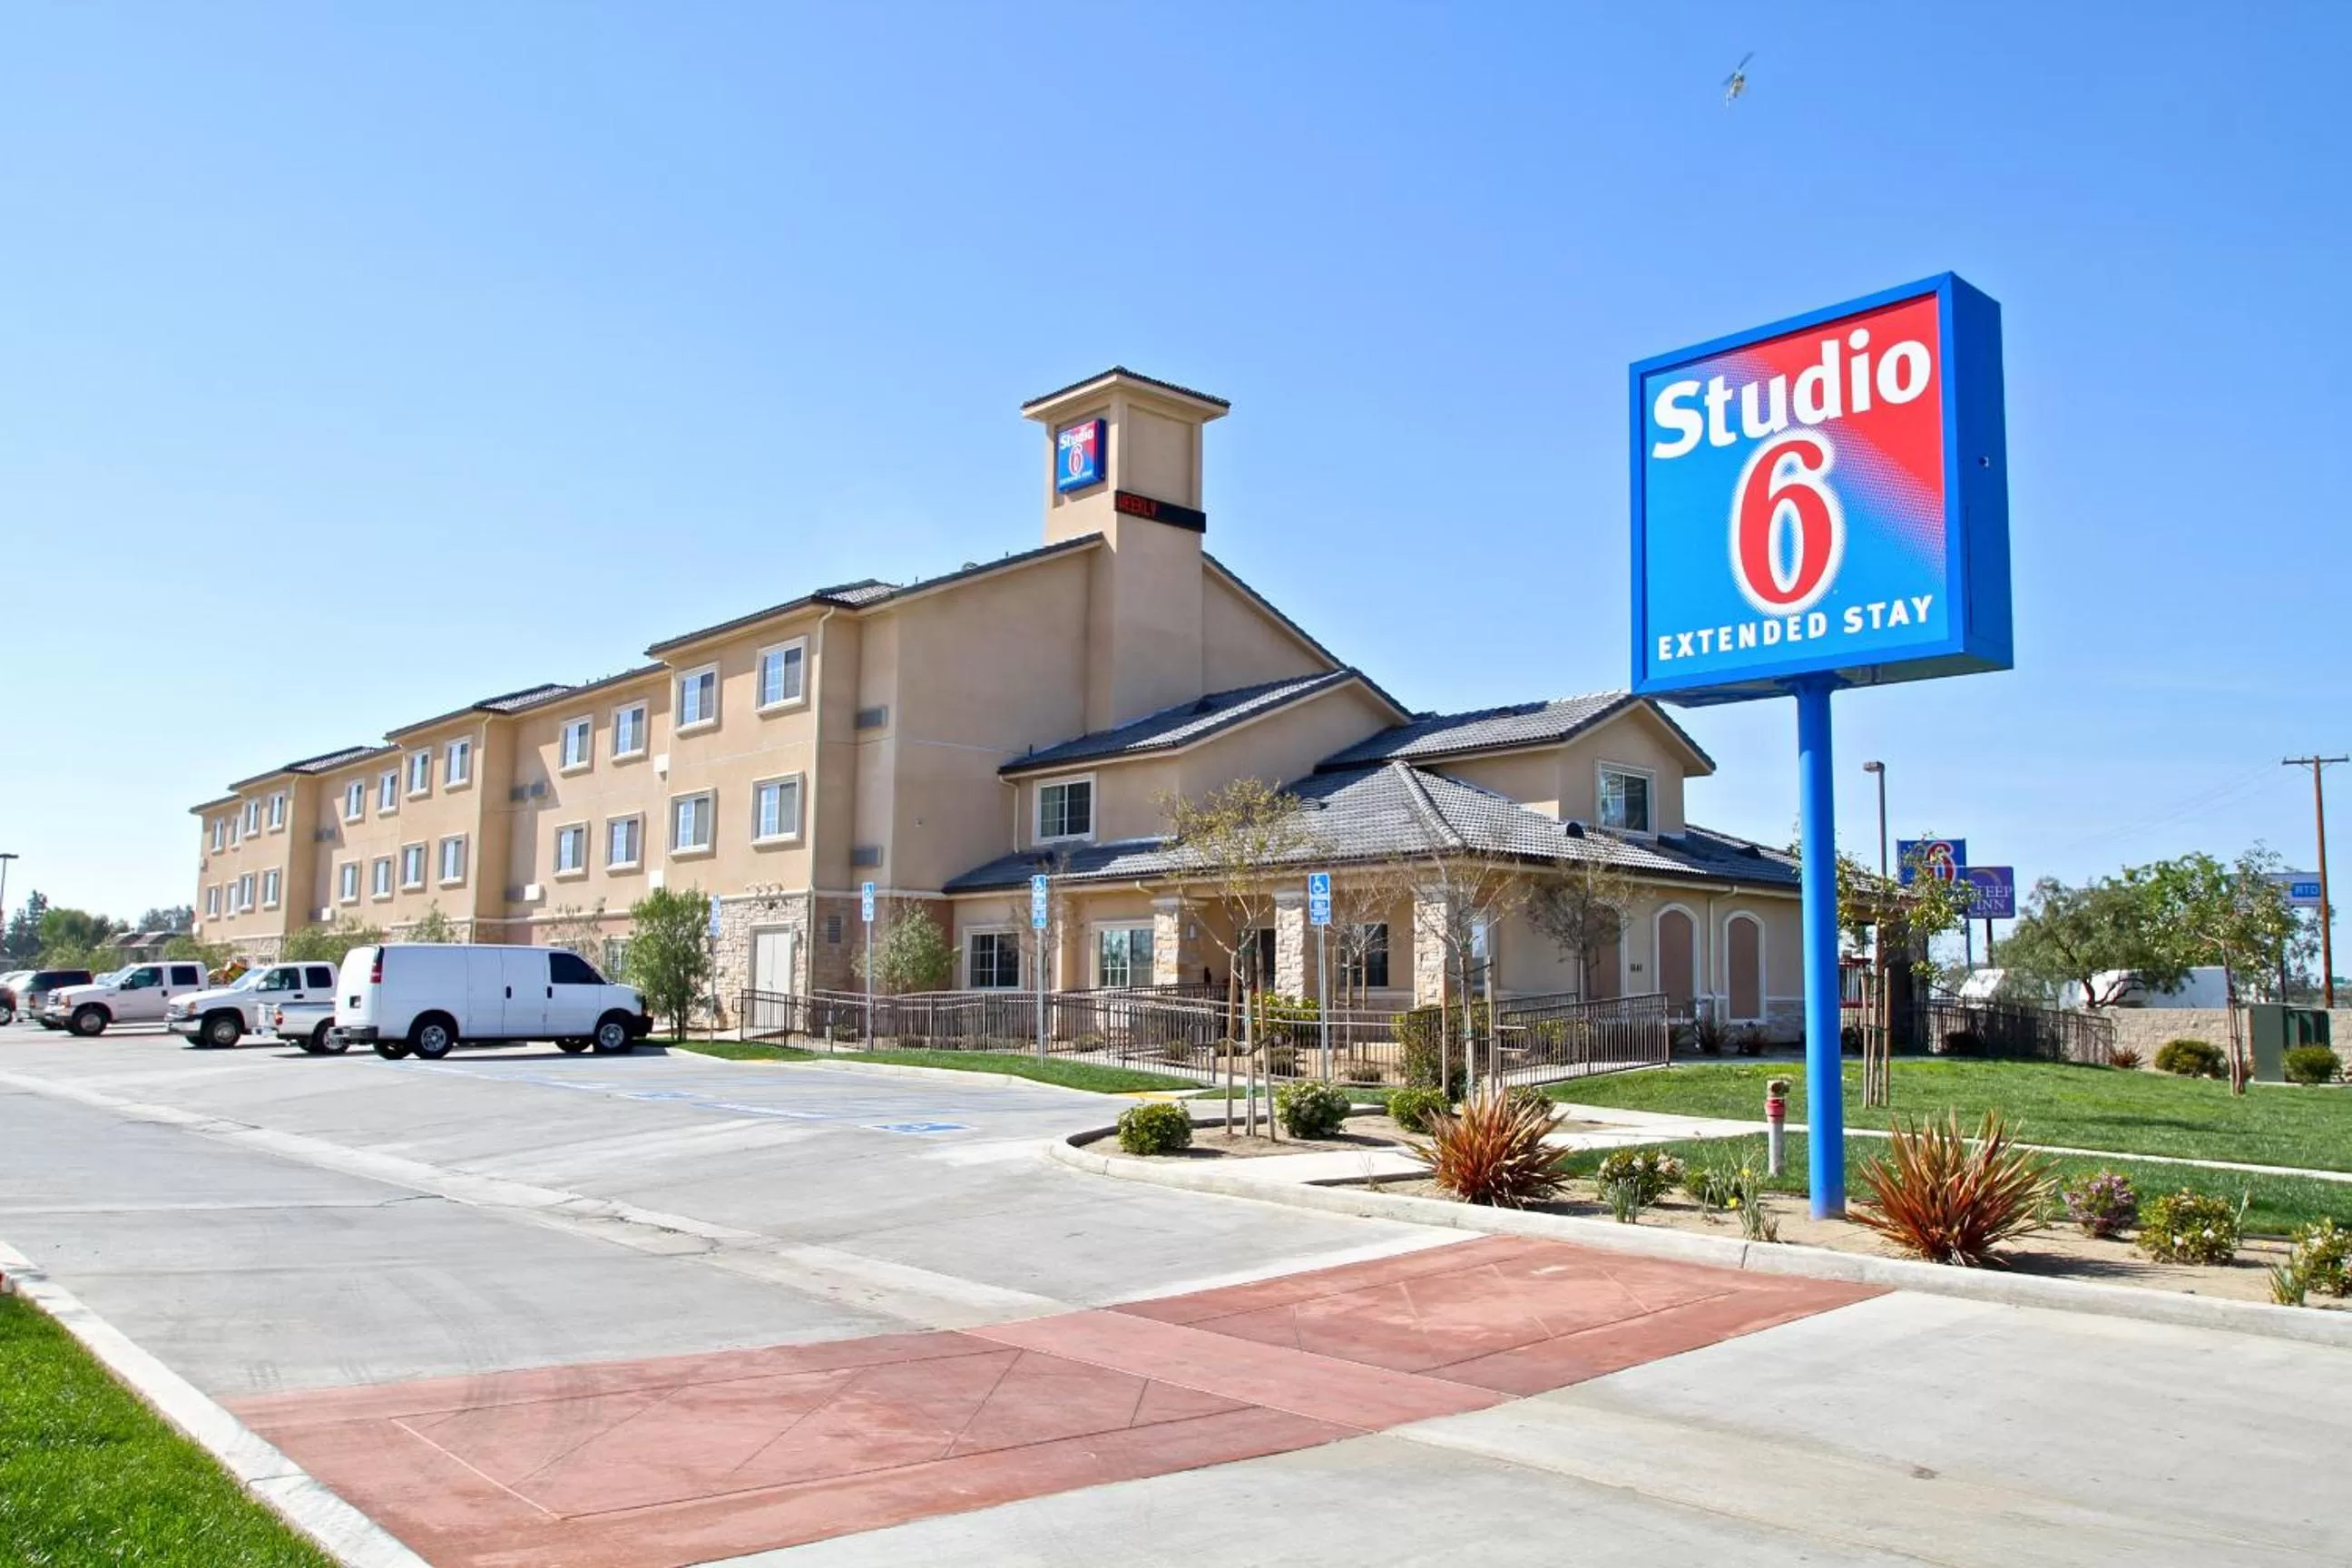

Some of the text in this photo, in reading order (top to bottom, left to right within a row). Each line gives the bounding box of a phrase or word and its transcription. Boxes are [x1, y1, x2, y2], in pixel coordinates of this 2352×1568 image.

[1651, 328, 1932, 459] Studio
[1060, 427, 1094, 450] Studio
[1070, 444, 1083, 475] 6
[1734, 434, 1840, 611] 6
[1658, 594, 1934, 661] EXTENDED STAY
[1976, 899, 2005, 910] INN
